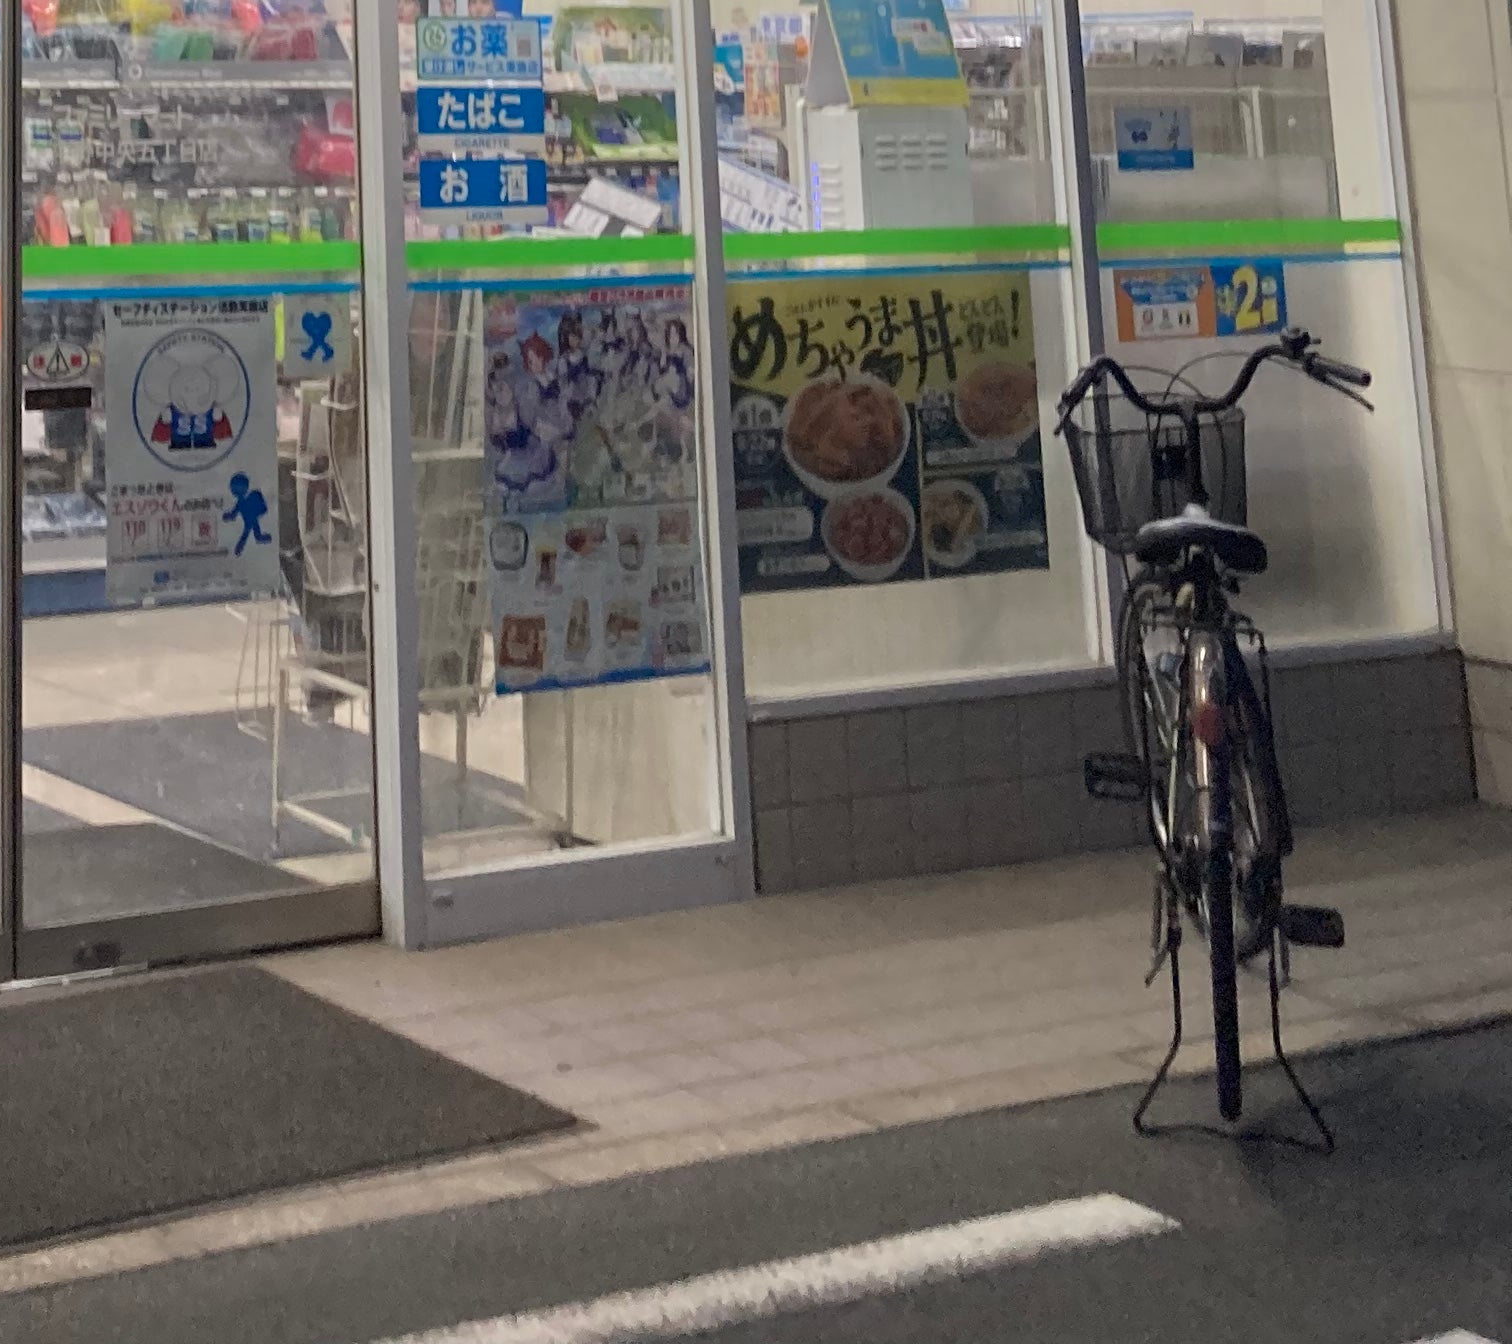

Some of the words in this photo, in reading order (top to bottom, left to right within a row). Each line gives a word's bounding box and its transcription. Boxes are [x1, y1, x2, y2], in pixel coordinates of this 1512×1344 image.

[438, 91, 525, 130] たばこ
[439, 164, 529, 204] お酒
[730, 288, 965, 393] めちゃうま丼
